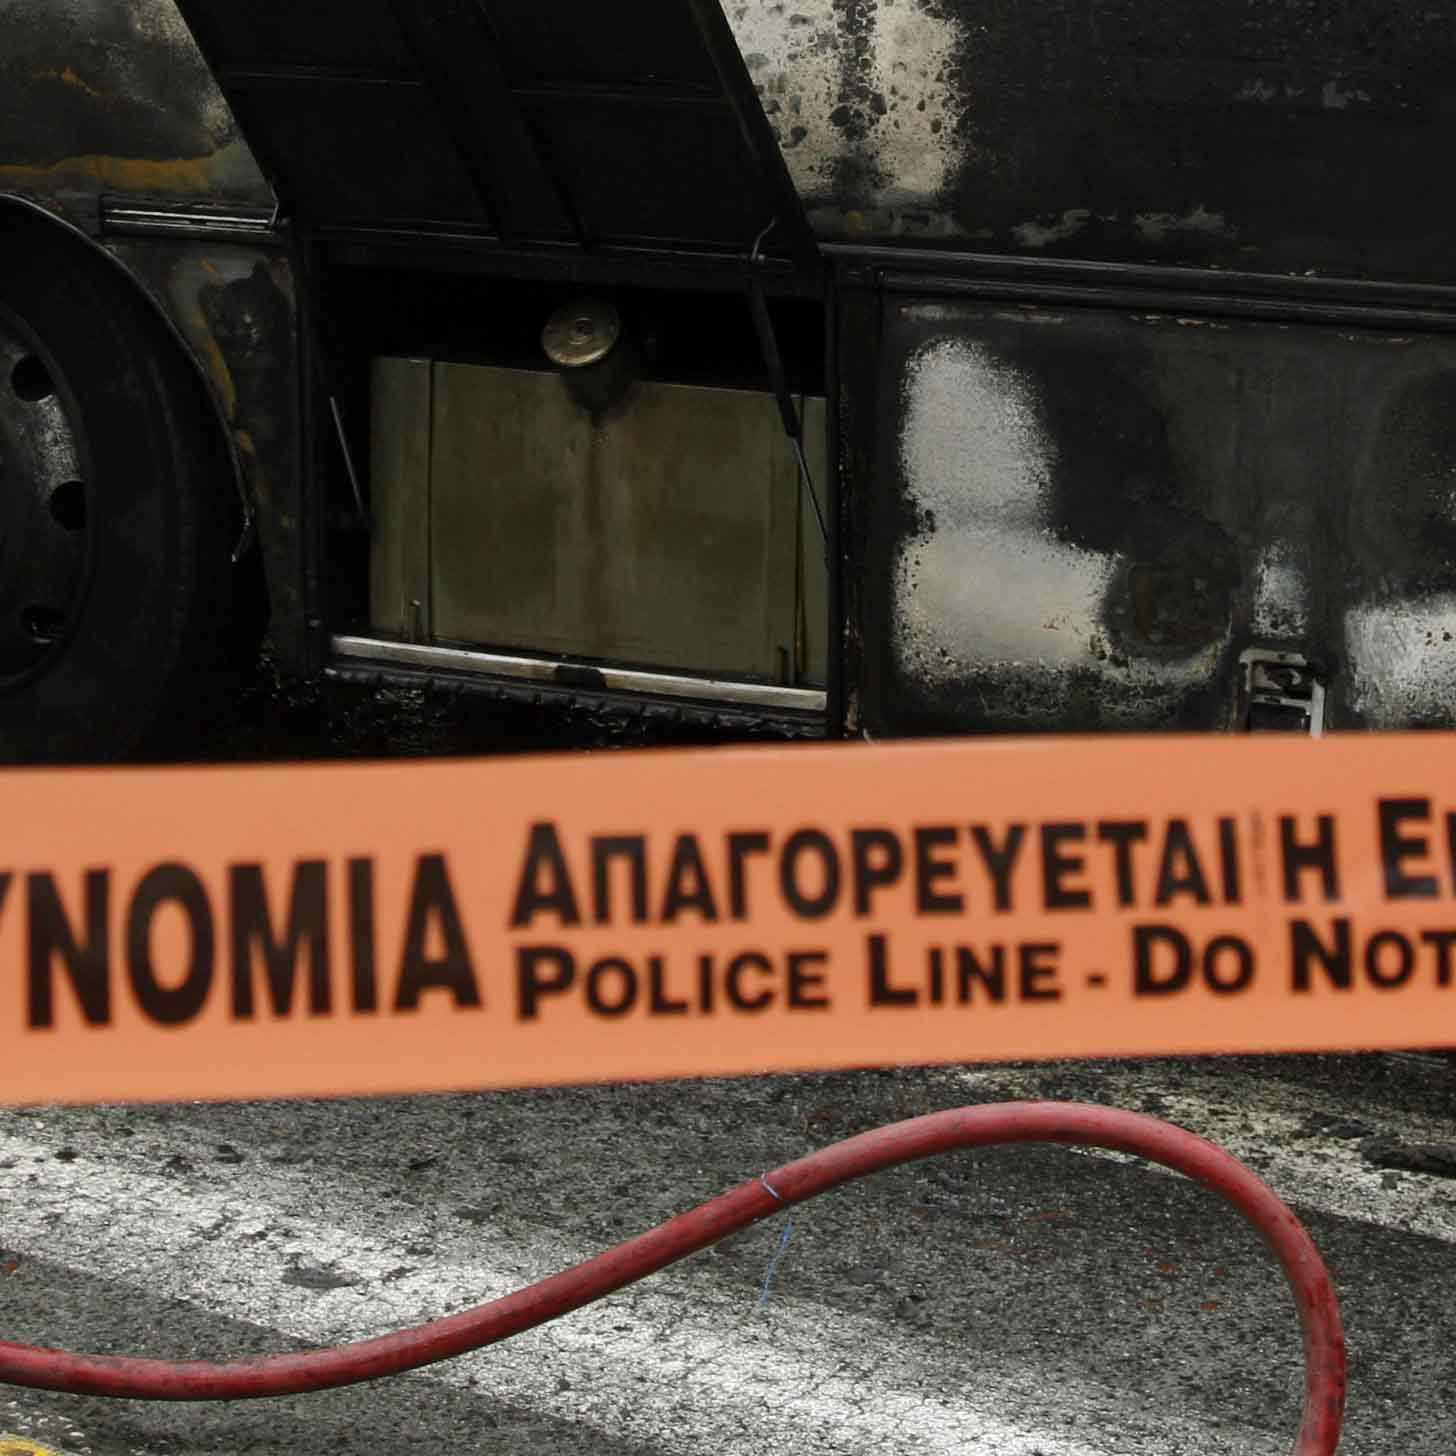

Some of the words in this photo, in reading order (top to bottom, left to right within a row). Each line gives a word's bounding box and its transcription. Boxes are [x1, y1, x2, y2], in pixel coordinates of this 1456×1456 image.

[510, 819, 1242, 929] ΑΠΑΓΟΡΕΥΕΤΑΙ
[1279, 815, 1340, 903] Η
[516, 944, 831, 1022] POLICE
[867, 934, 1061, 1008] LINE
[1132, 924, 1256, 997] DO
